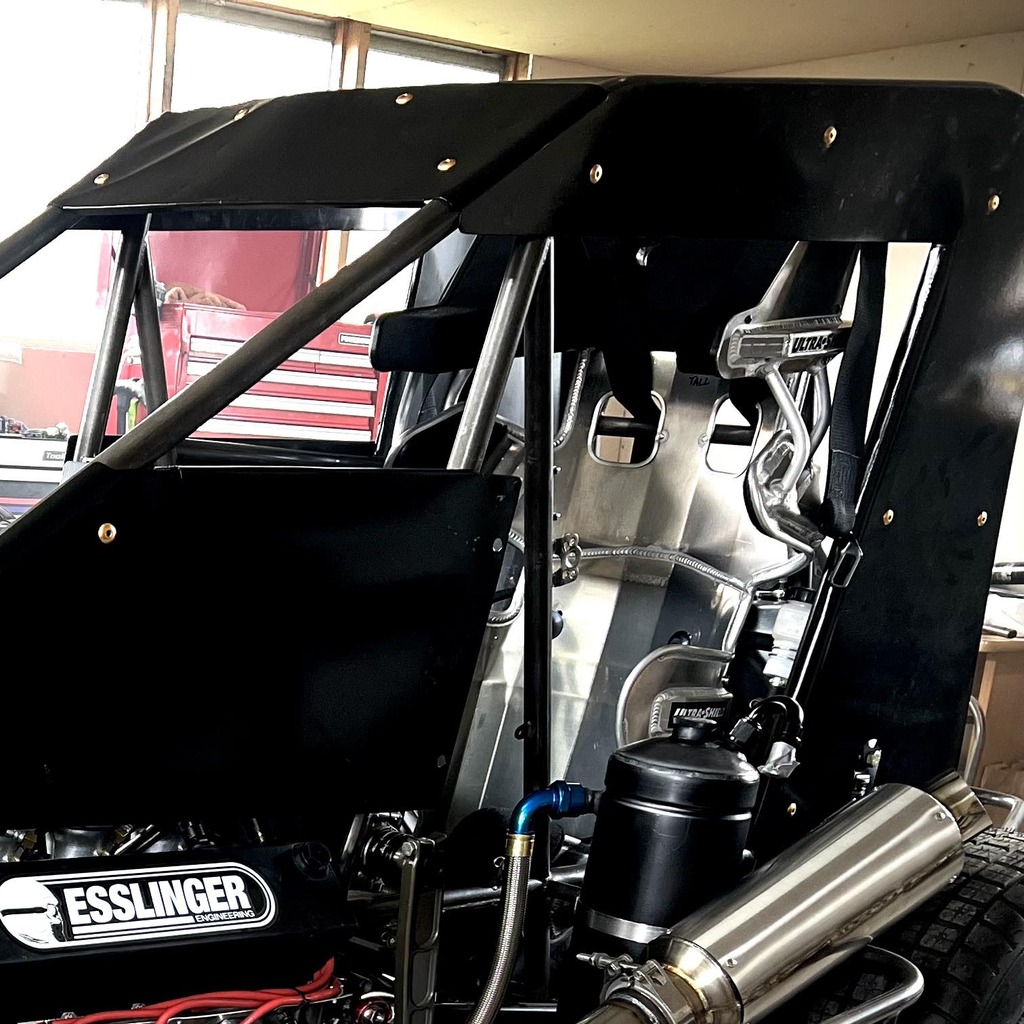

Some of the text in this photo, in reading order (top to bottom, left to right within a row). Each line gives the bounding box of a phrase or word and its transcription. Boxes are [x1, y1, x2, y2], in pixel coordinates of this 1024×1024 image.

[689, 376, 710, 387] TALL
[63, 875, 252, 926] ESSLINGER
[194, 909, 255, 923] ENGINEERING
